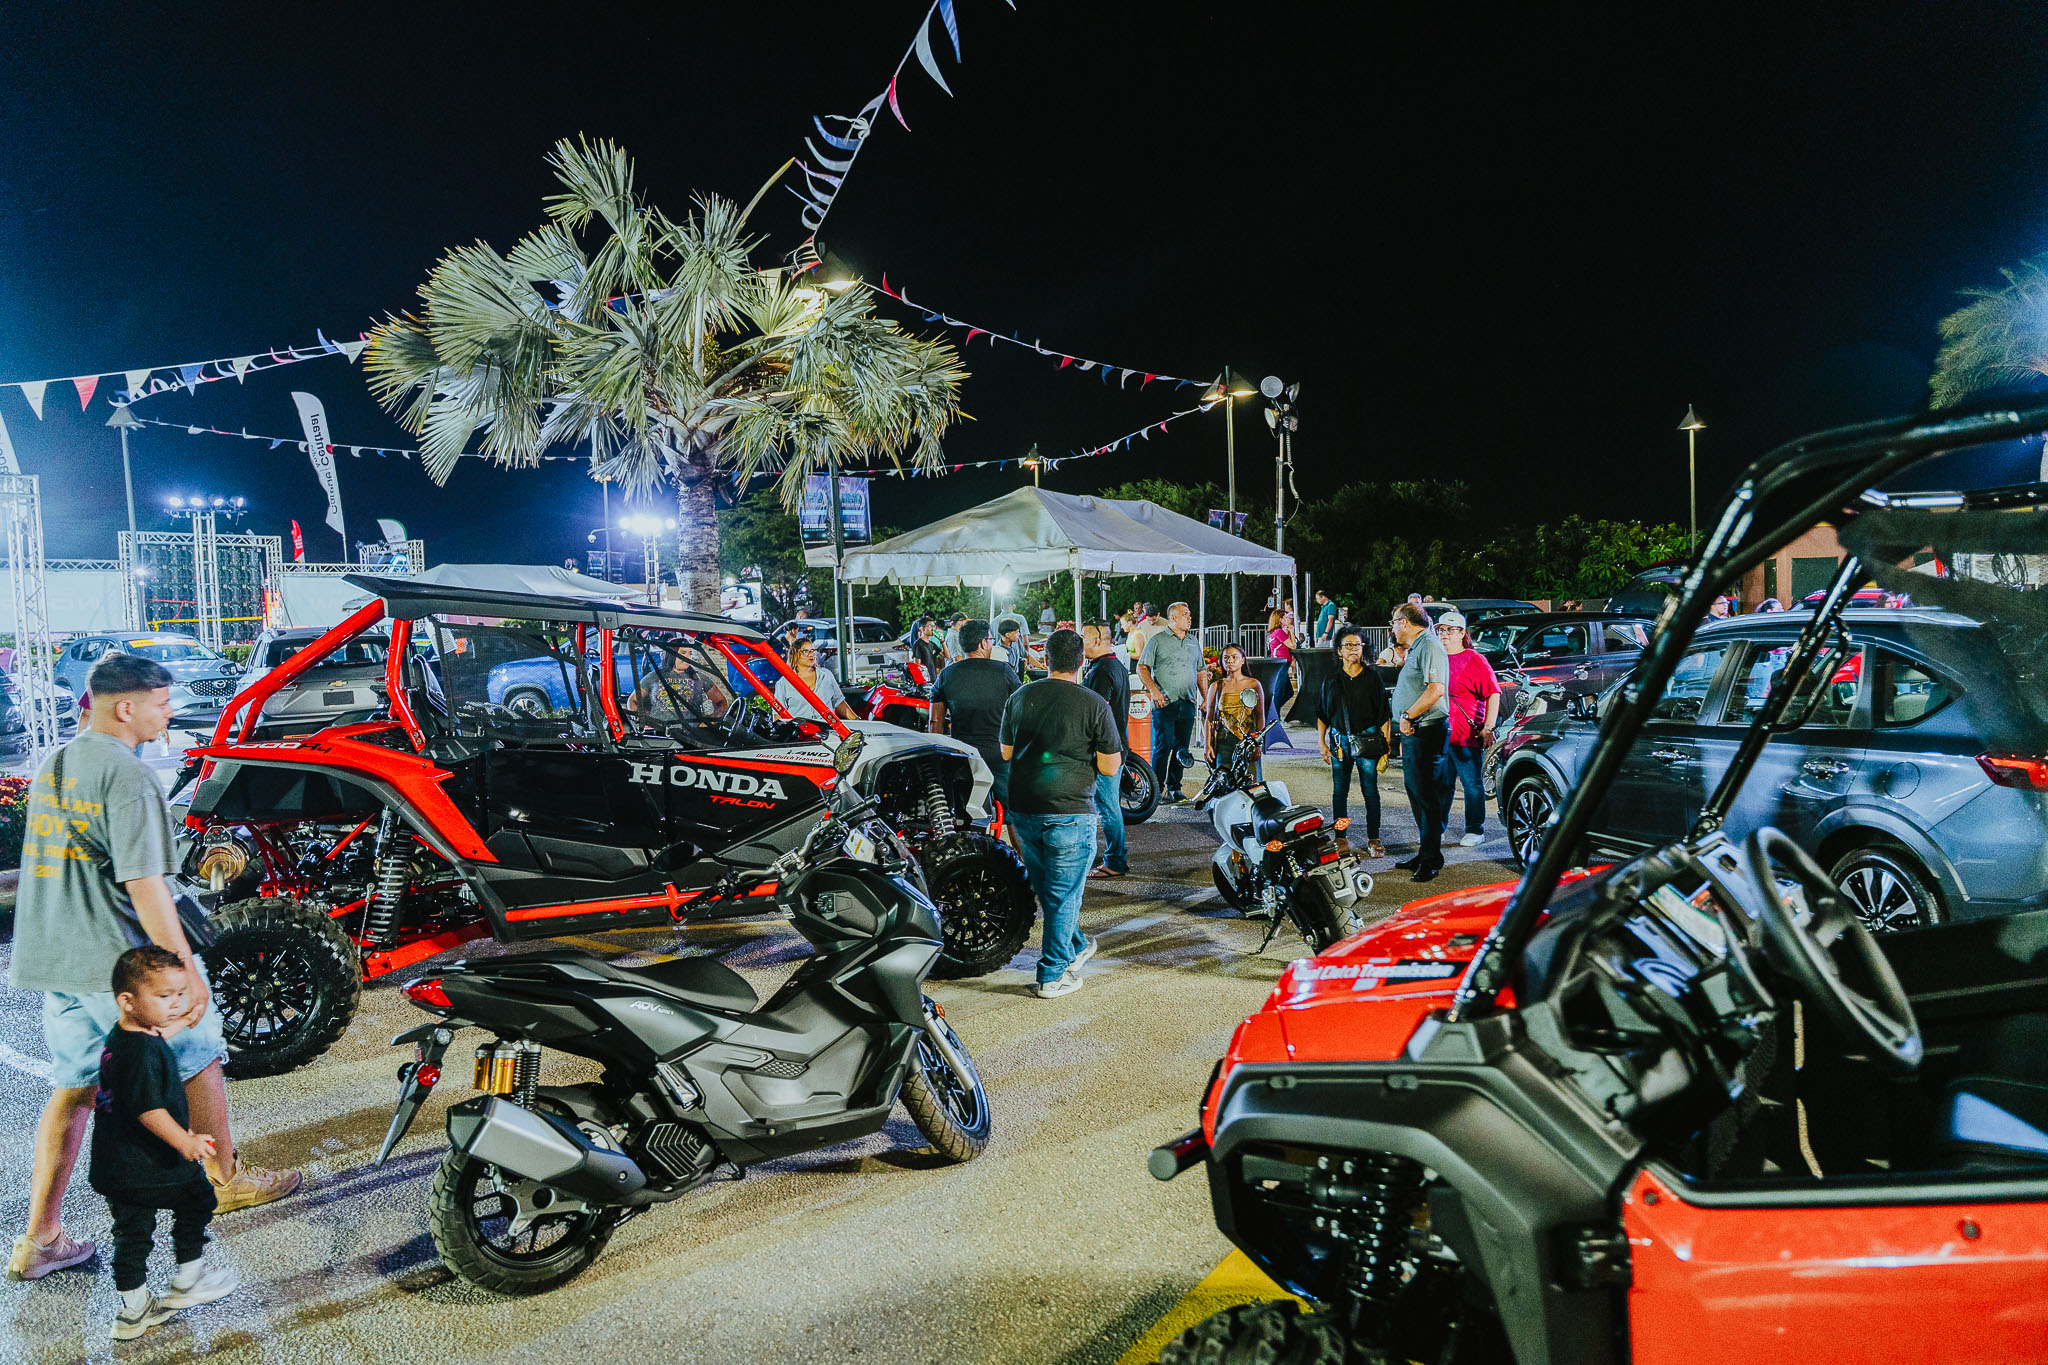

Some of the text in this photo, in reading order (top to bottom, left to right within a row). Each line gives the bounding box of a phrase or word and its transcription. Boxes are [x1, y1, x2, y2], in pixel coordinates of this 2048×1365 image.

[628, 762, 788, 800] HONDA
[709, 795, 776, 809] TALON
[630, 1000, 661, 1011] ADV
